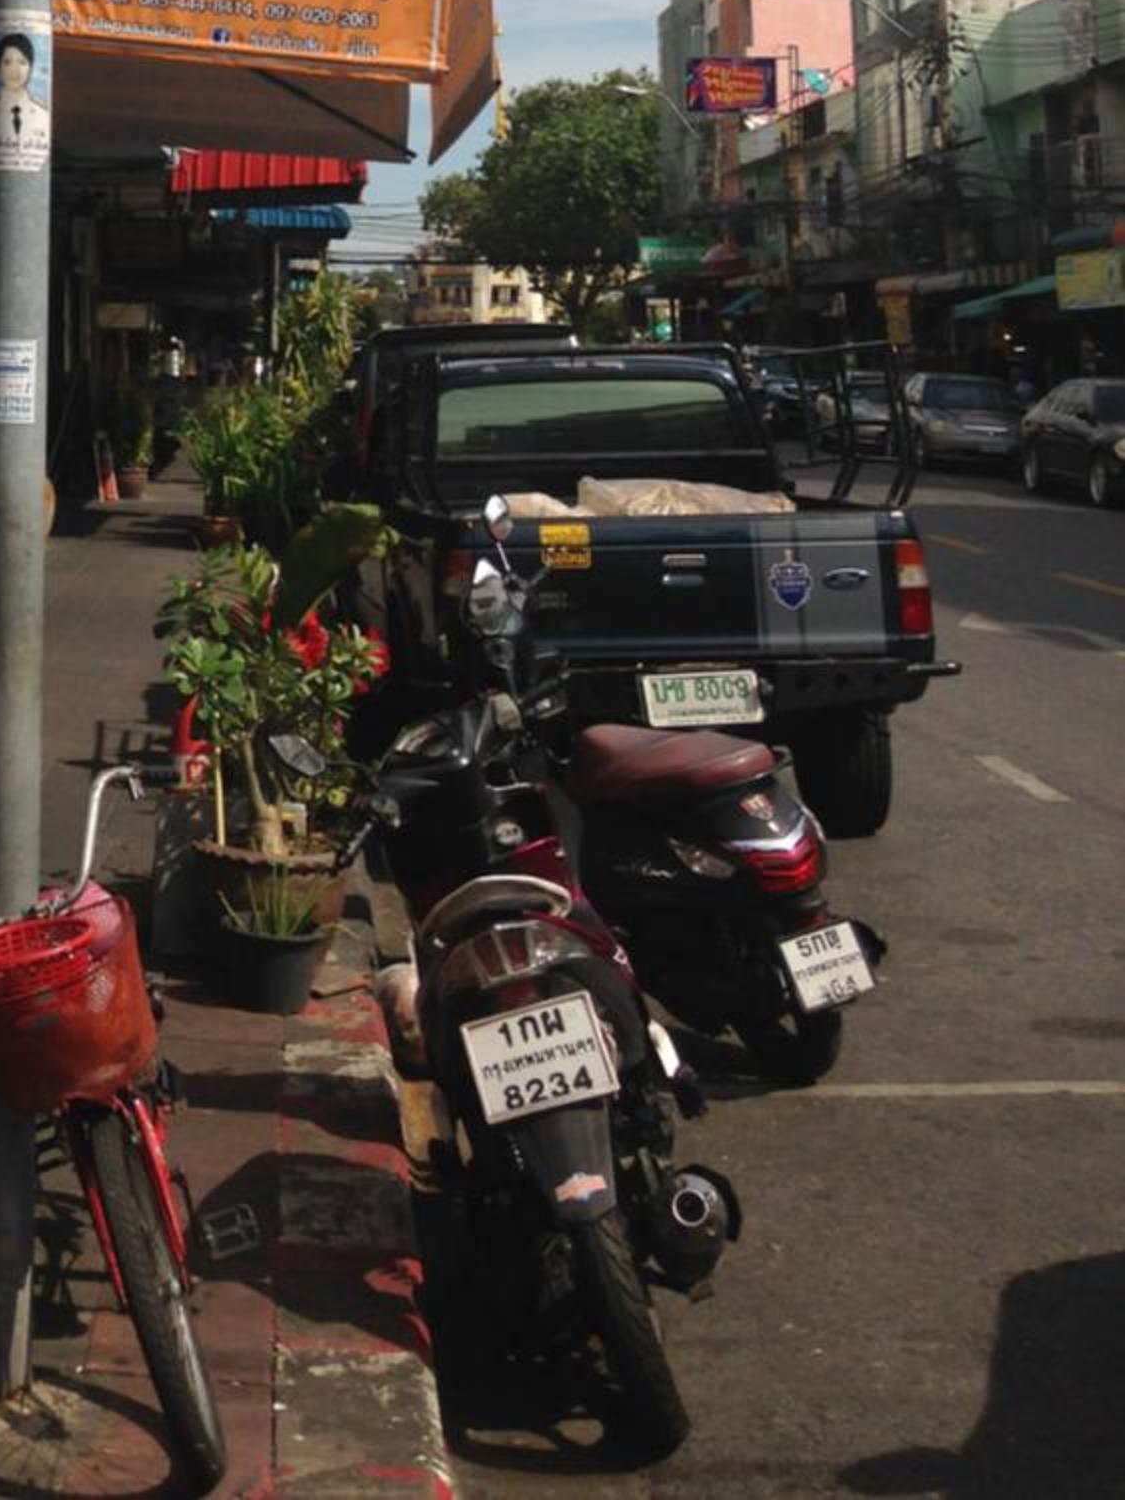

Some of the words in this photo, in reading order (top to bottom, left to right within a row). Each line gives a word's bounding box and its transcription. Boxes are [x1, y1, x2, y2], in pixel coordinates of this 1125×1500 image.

[481, 1037, 596, 1082] กรุงเทพมหานคร
[503, 1065, 594, 1111] 8234
